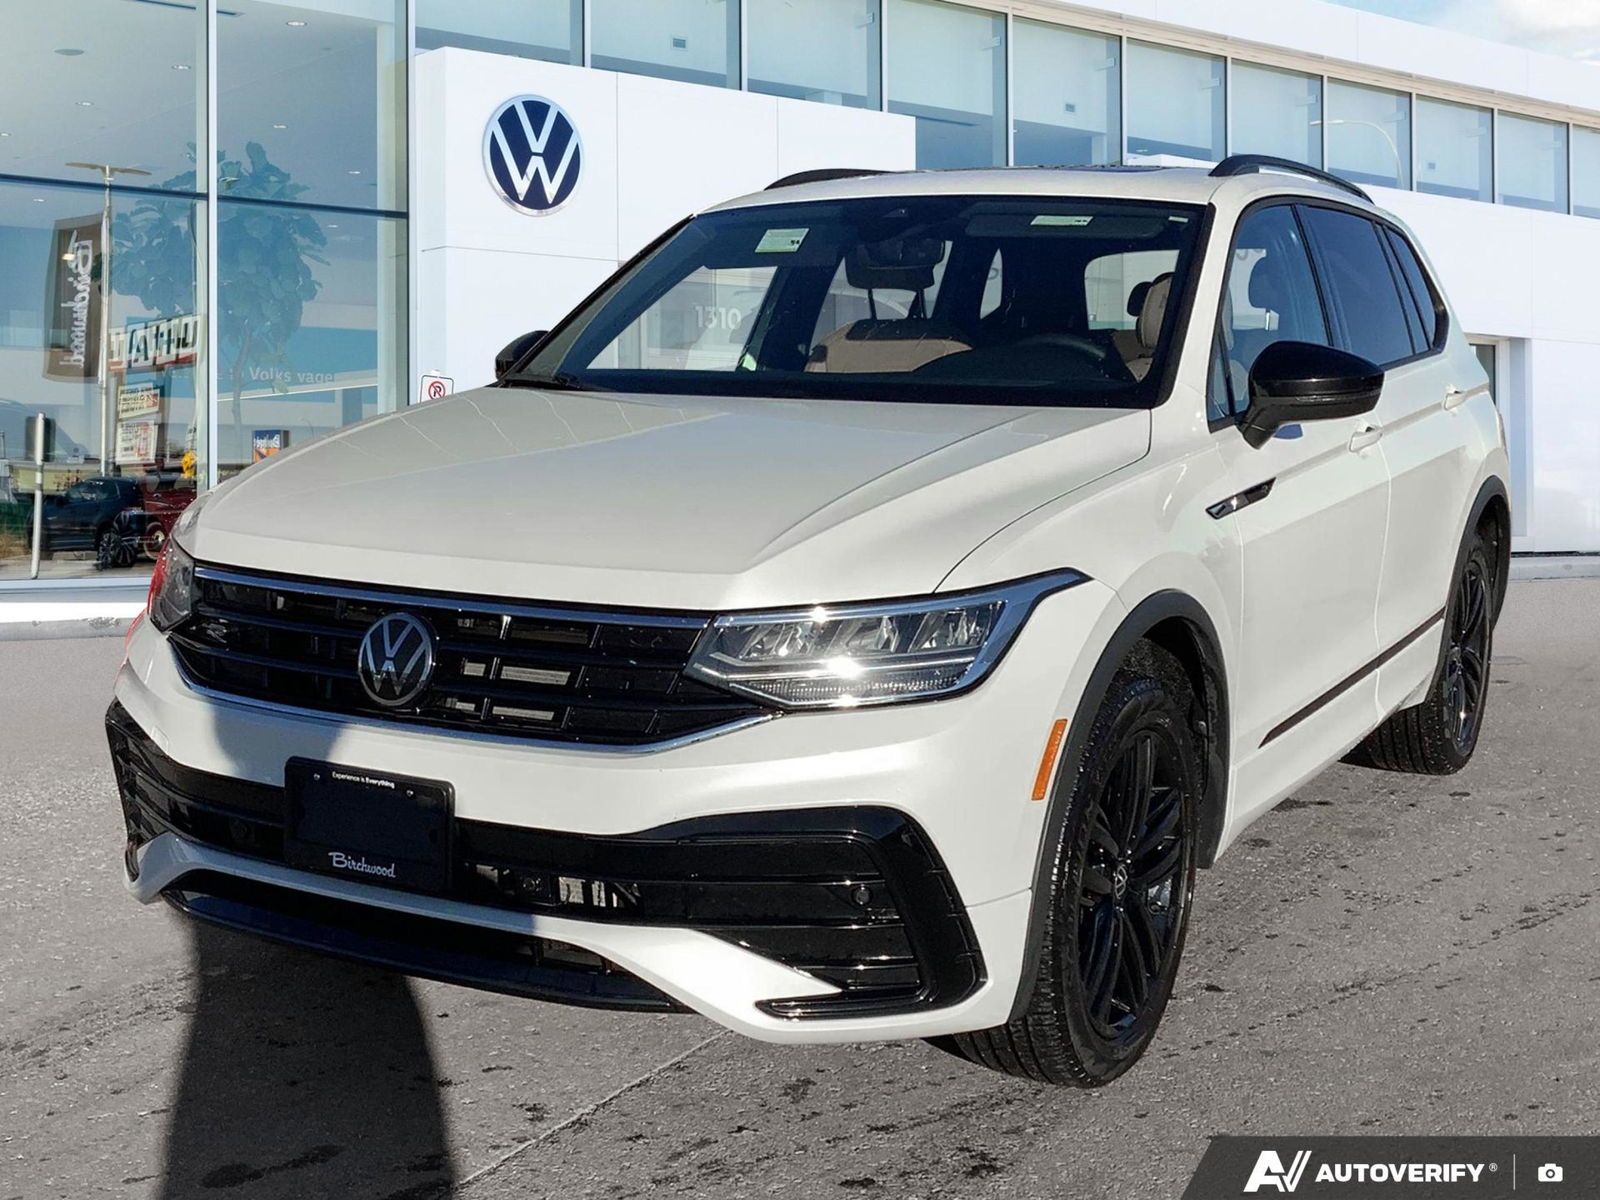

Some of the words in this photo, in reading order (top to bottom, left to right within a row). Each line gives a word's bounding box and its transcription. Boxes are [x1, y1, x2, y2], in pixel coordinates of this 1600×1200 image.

[487, 97, 581, 207] VW
[694, 305, 741, 329] 1310
[361, 616, 430, 698] VW
[332, 771, 360, 782] Experience
[365, 776, 395, 789] Everything
[328, 852, 396, 878] Birchwood
